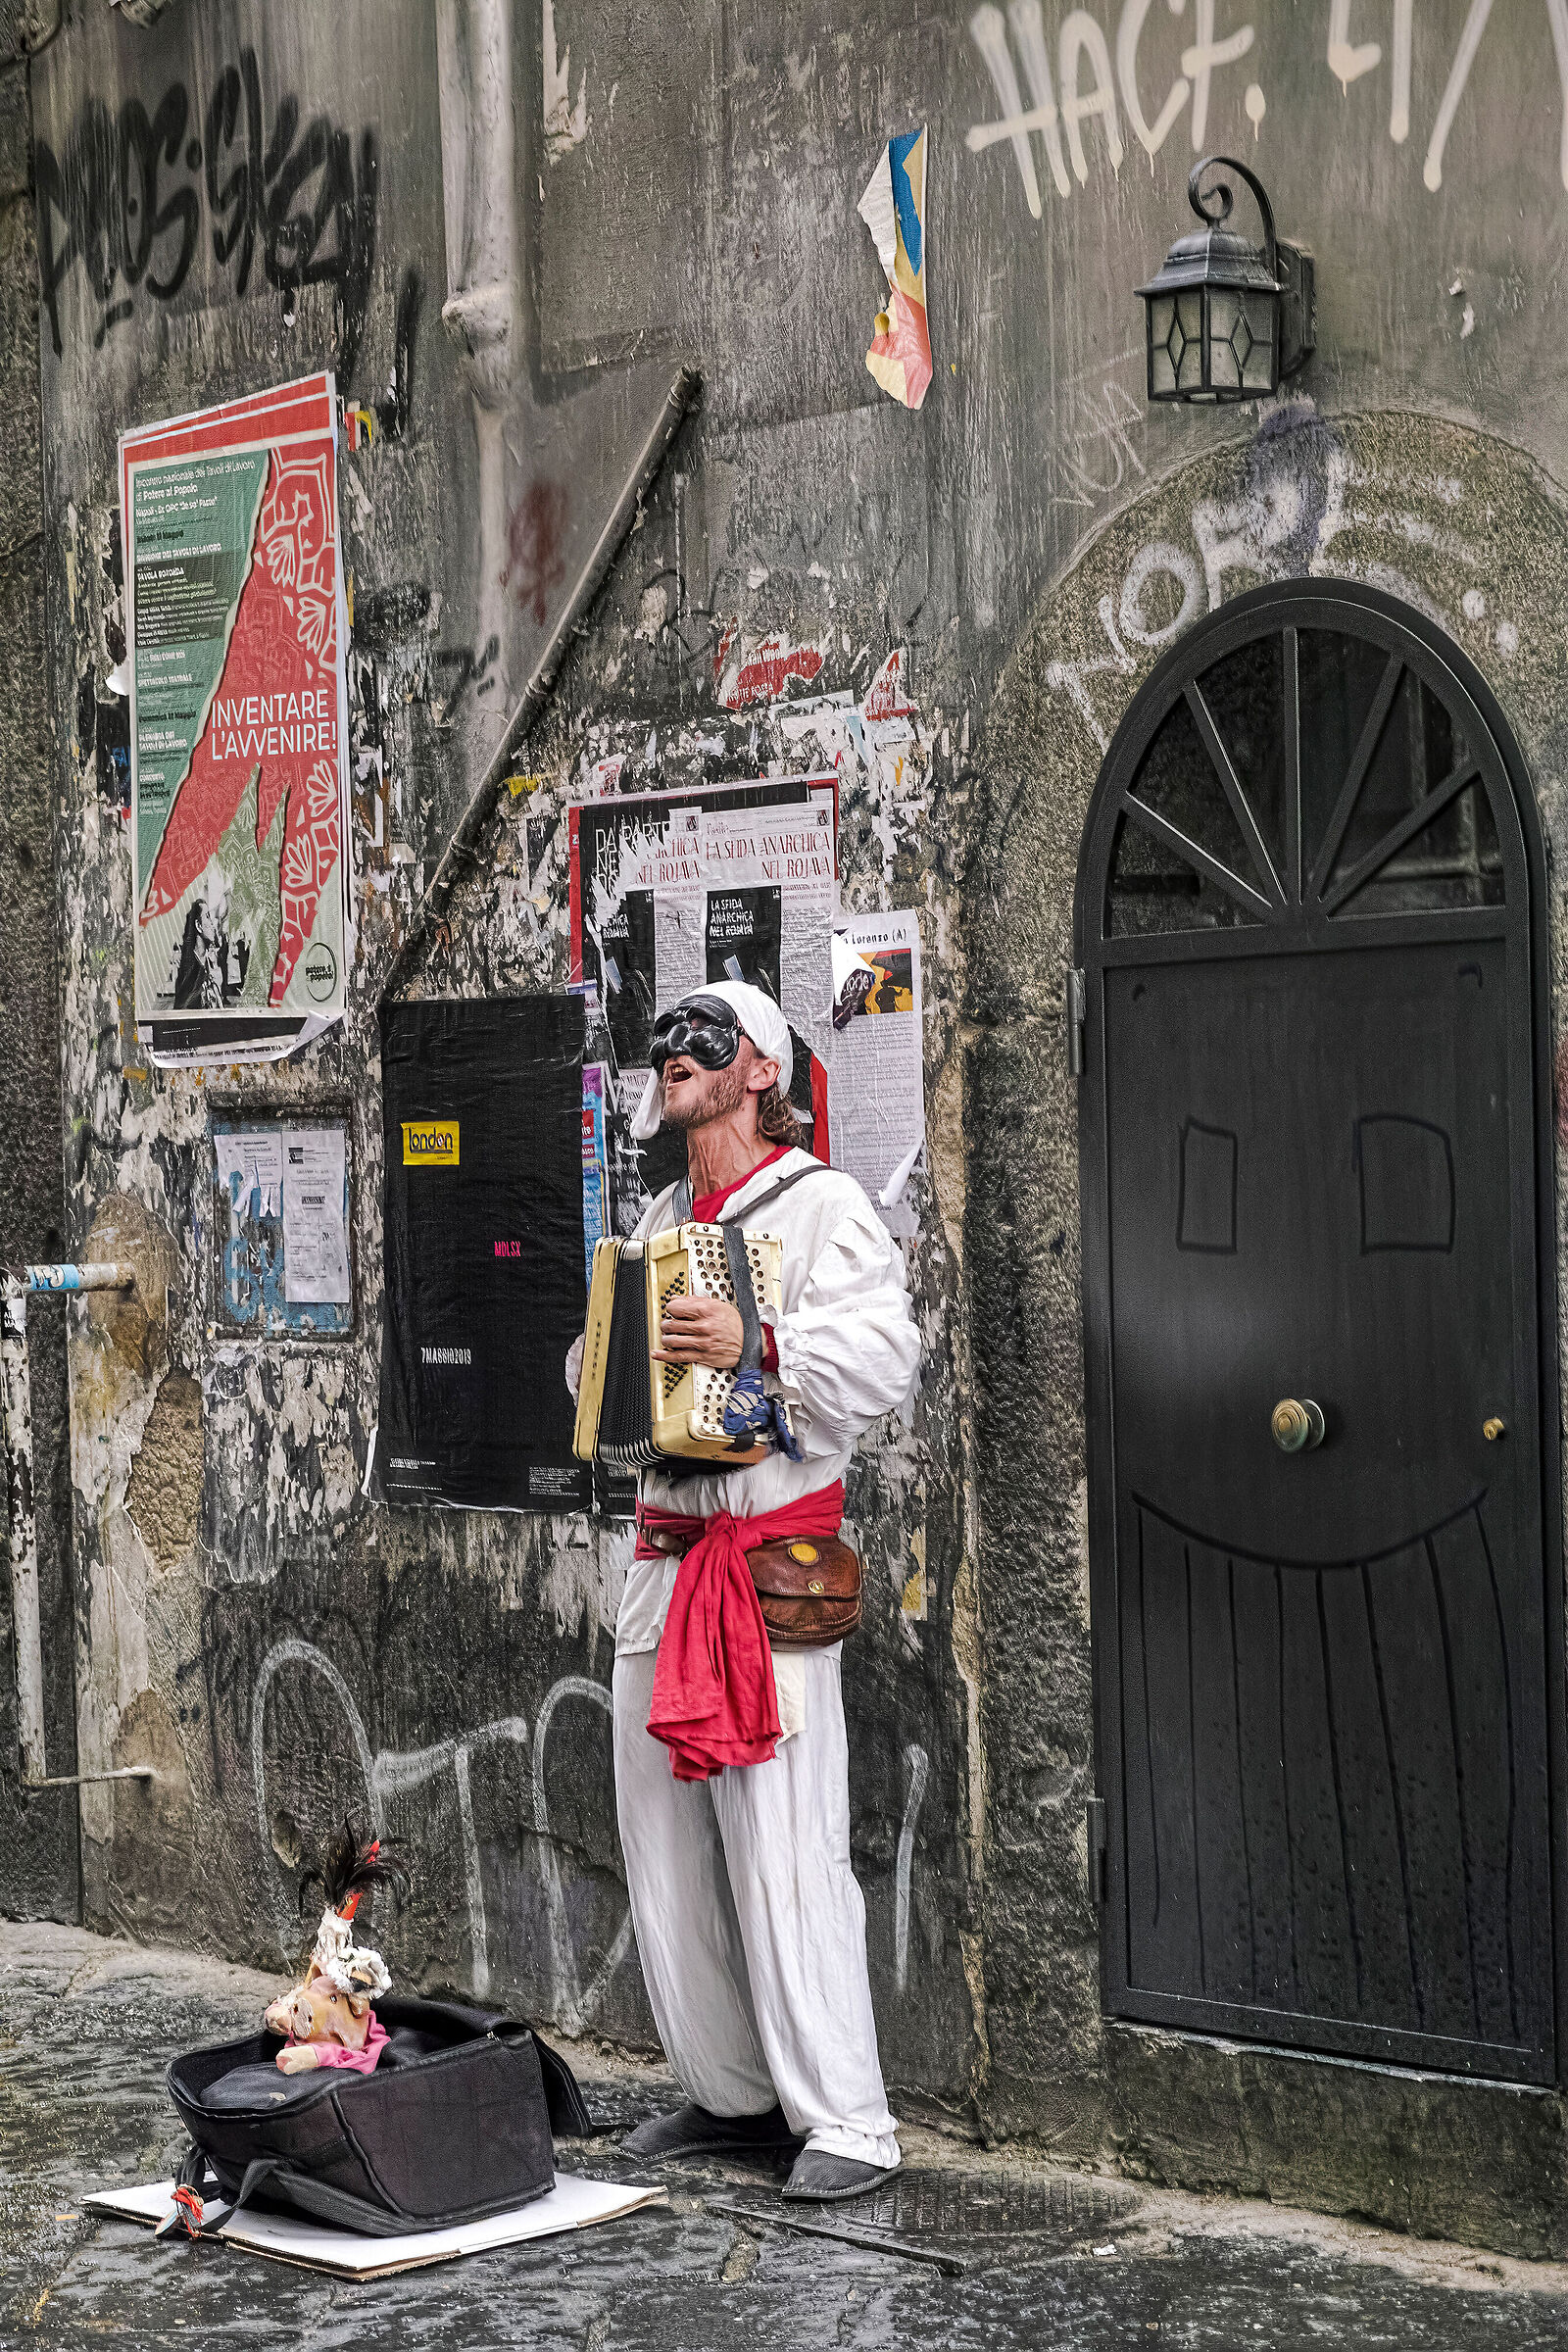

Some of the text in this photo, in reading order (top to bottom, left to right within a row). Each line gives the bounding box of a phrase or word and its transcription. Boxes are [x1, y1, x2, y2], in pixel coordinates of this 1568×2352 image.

[143, 490, 166, 501] Potere
[212, 689, 329, 729] INVENTARE
[212, 721, 336, 760] L'AVVENIRE!
[721, 898, 743, 910] SFIDA
[710, 909, 755, 925] ANARCHICA
[408, 1127, 454, 1154] london
[494, 1241, 521, 1258] MDLSX
